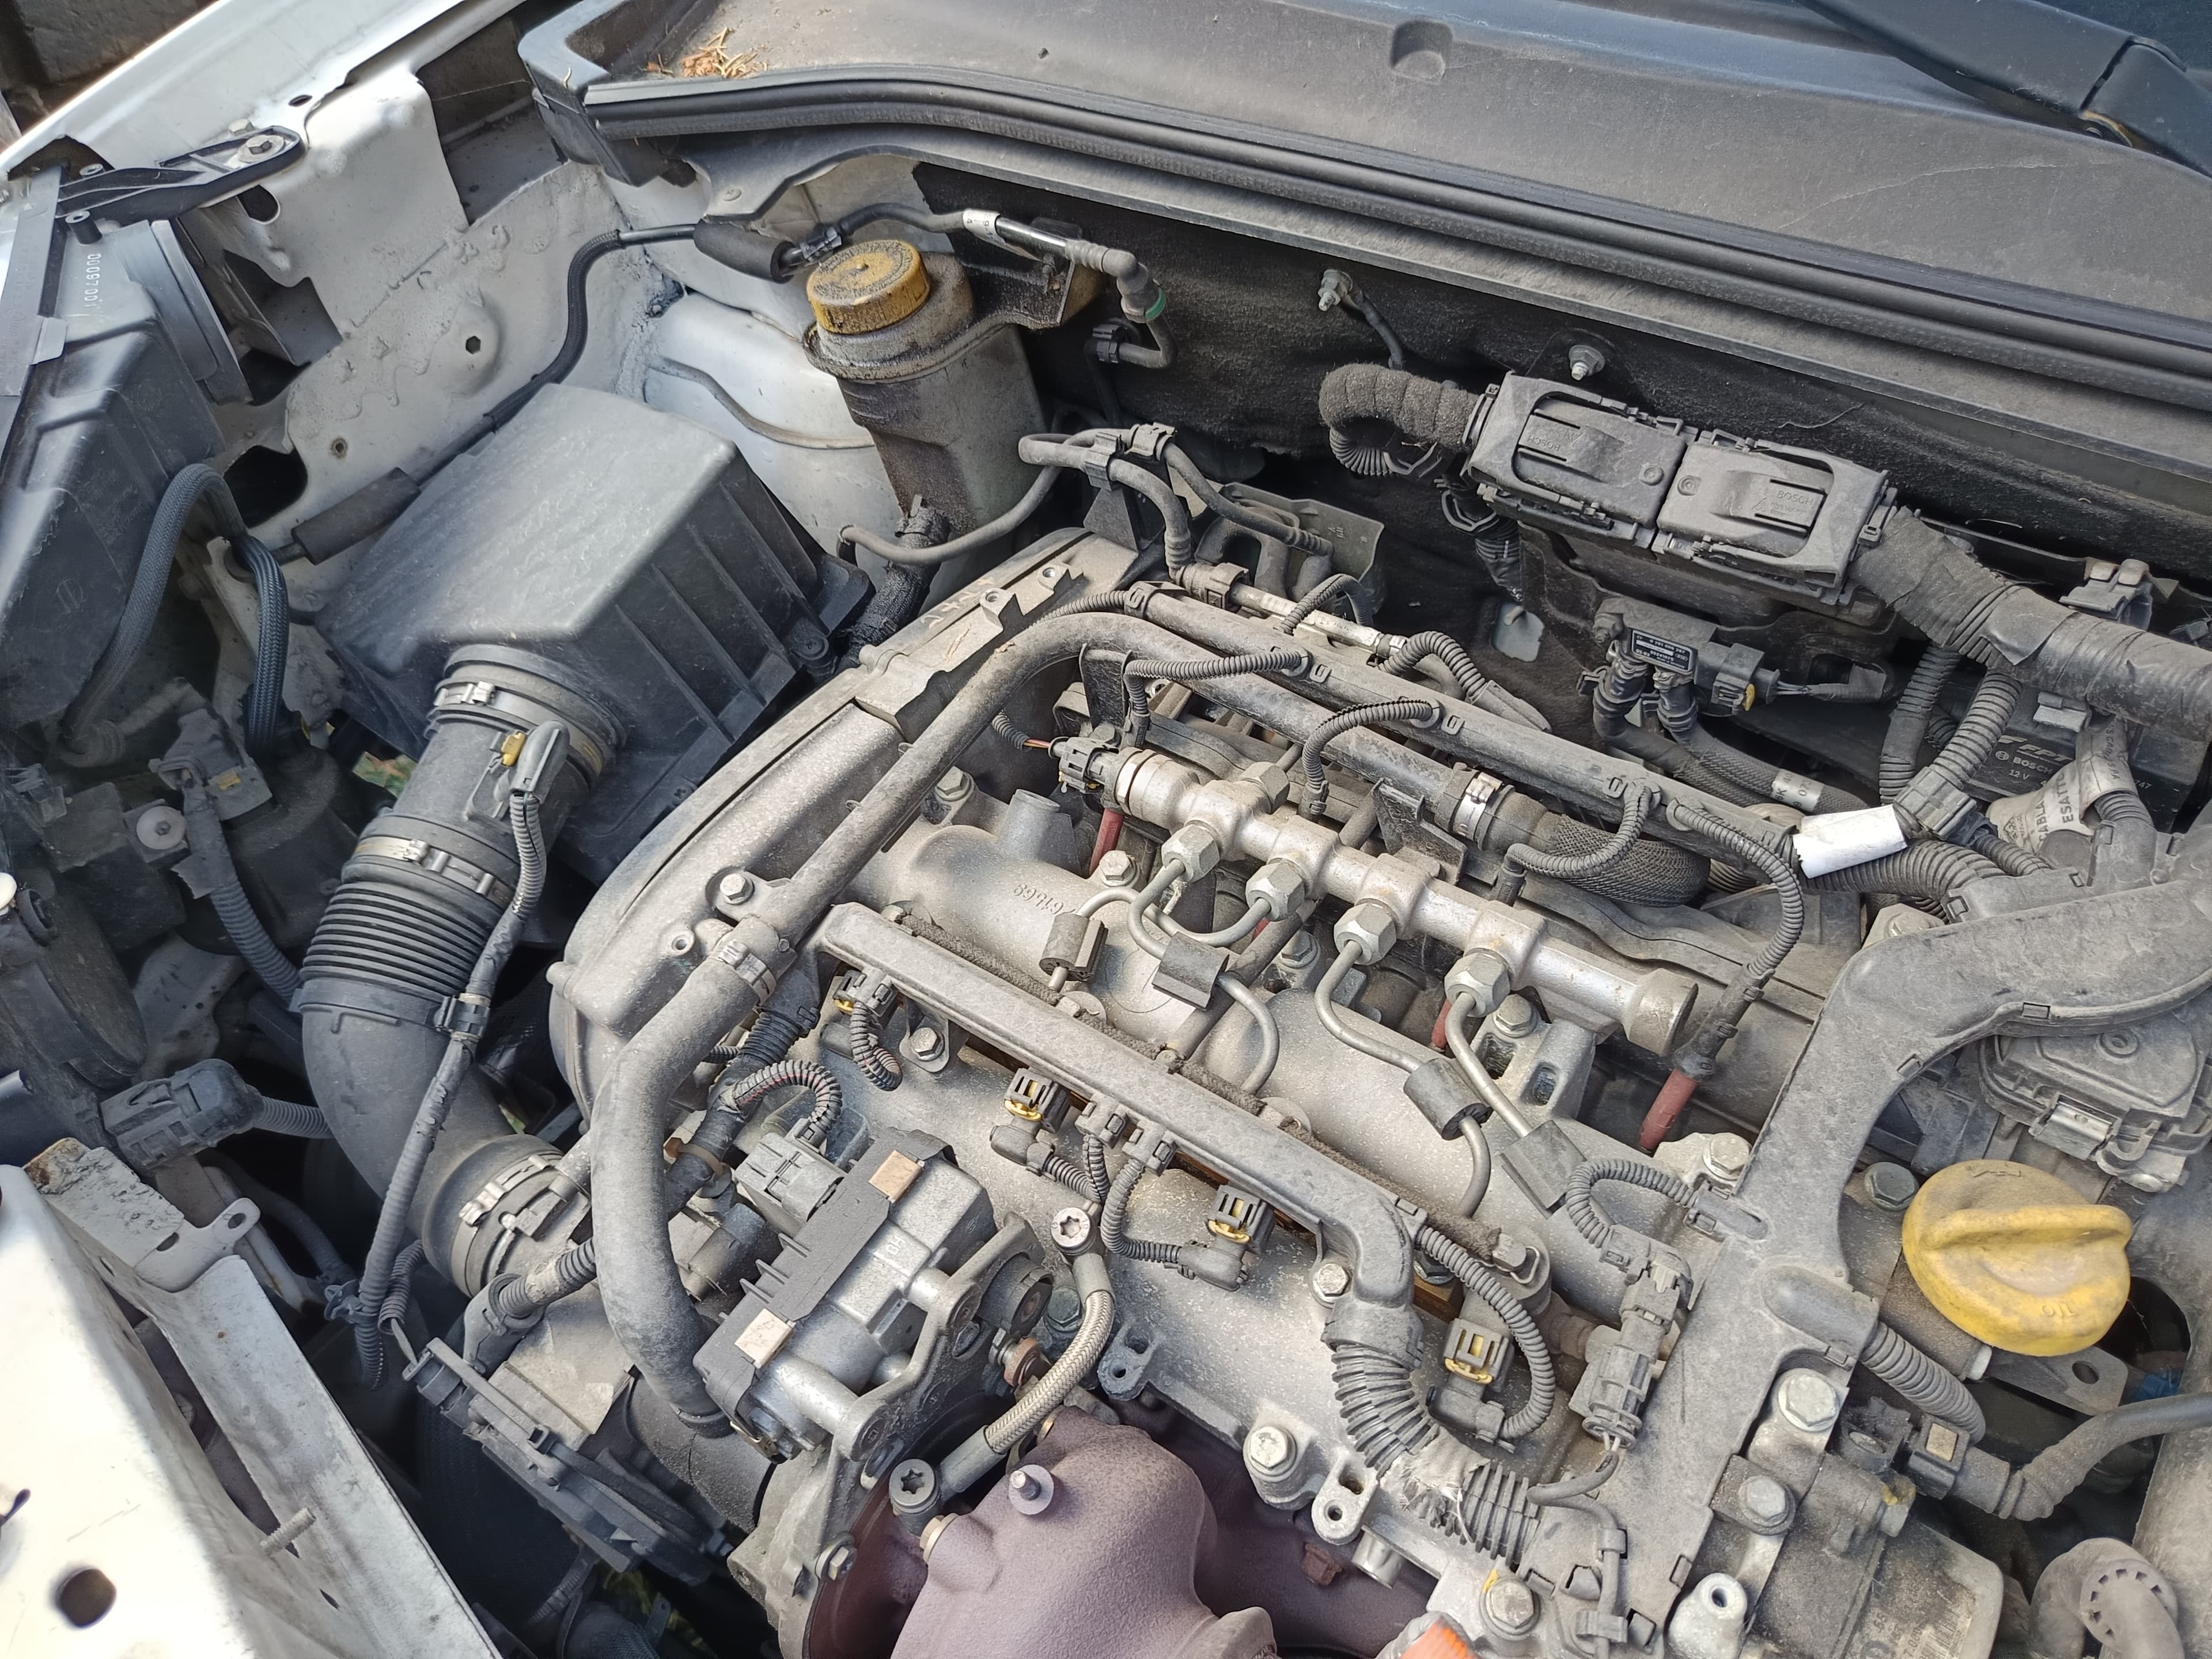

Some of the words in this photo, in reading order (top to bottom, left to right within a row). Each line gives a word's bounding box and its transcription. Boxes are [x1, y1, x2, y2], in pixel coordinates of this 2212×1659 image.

[1527, 434, 1561, 452] BOSCH
[1776, 490, 1814, 505] BOSCH
[2018, 744, 2074, 762] FPT
[2008, 768, 2021, 778] 12
[2013, 756, 2053, 775] BOSCH
